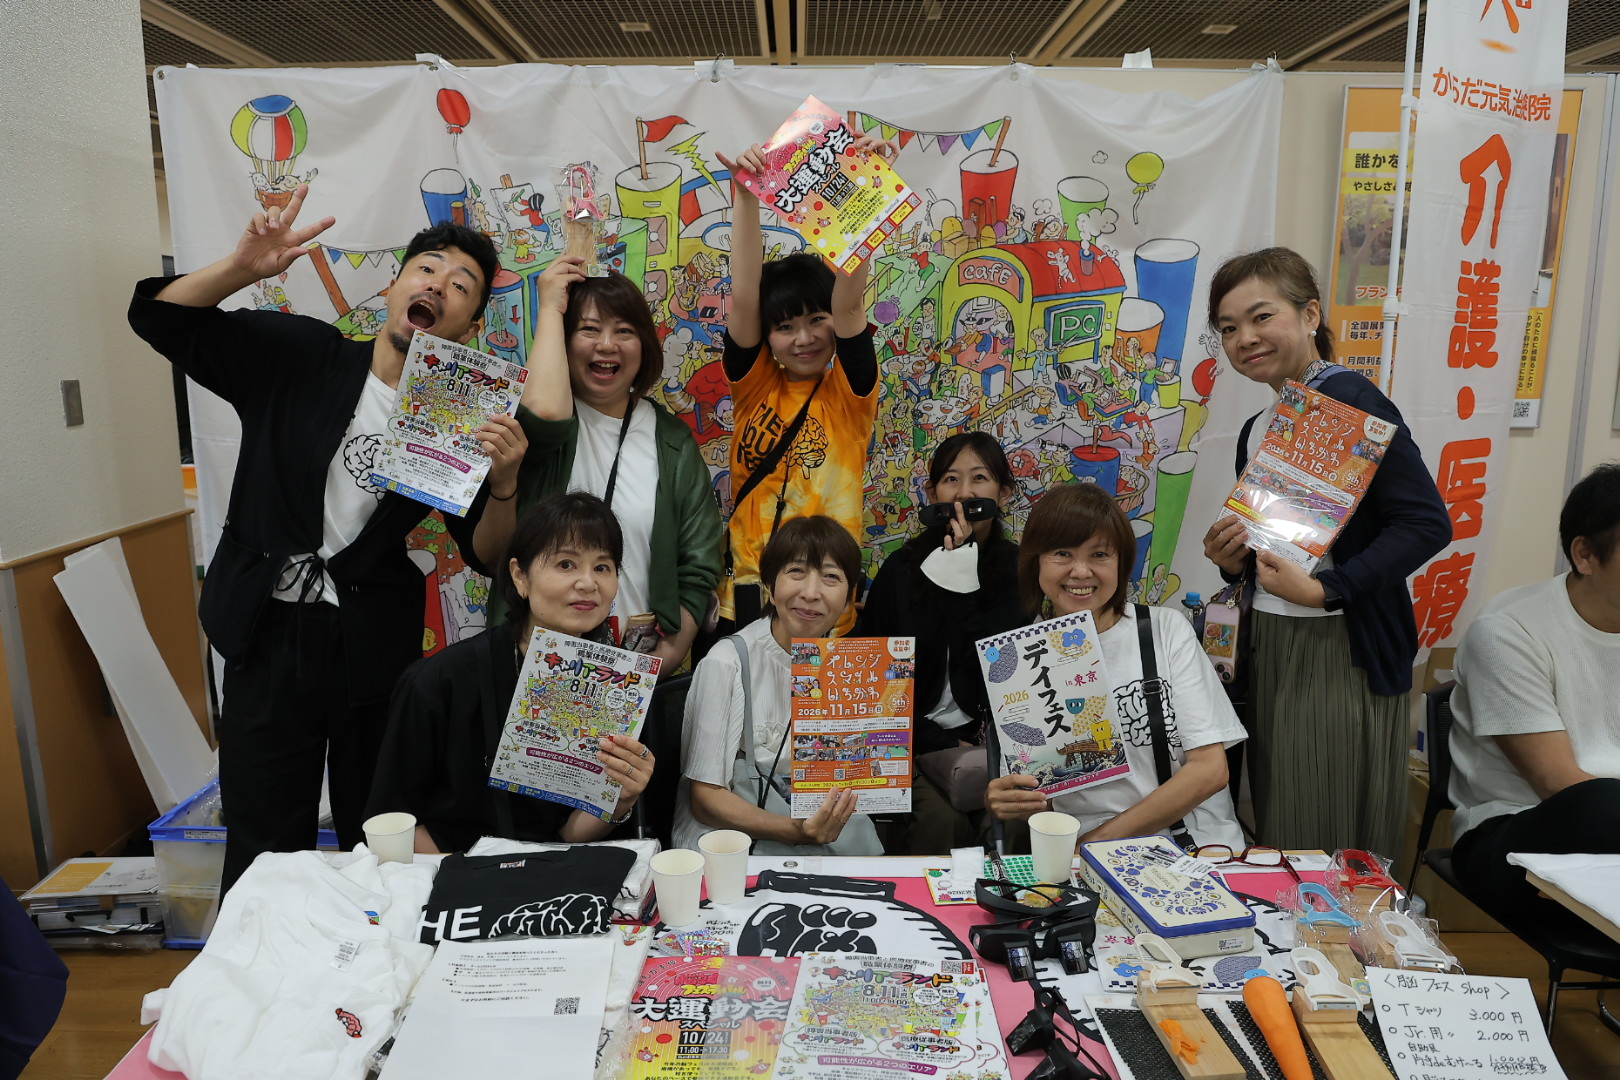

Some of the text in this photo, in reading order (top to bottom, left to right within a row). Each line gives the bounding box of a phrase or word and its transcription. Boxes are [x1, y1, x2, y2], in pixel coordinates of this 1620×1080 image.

[774, 123, 855, 213] 大運動会
[1060, 314, 1096, 339] PC
[423, 353, 510, 393] キャリアランド
[826, 653, 882, 669] オレンジ
[543, 651, 642, 689] キャリアランド
[827, 670, 879, 686] スマイル
[1074, 670, 1098, 687] 東京
[827, 686, 880, 701] いちかわ
[1022, 638, 1072, 739] デイフェス
[1002, 689, 1030, 706] 2026
[822, 965, 954, 987] キャリアランド
[632, 996, 792, 1022] 大運動会
[679, 1020, 742, 1030] スペシャル
[682, 1031, 724, 1045] 10/24
[822, 1057, 934, 1073] 可能性が広がる2つのエリア
